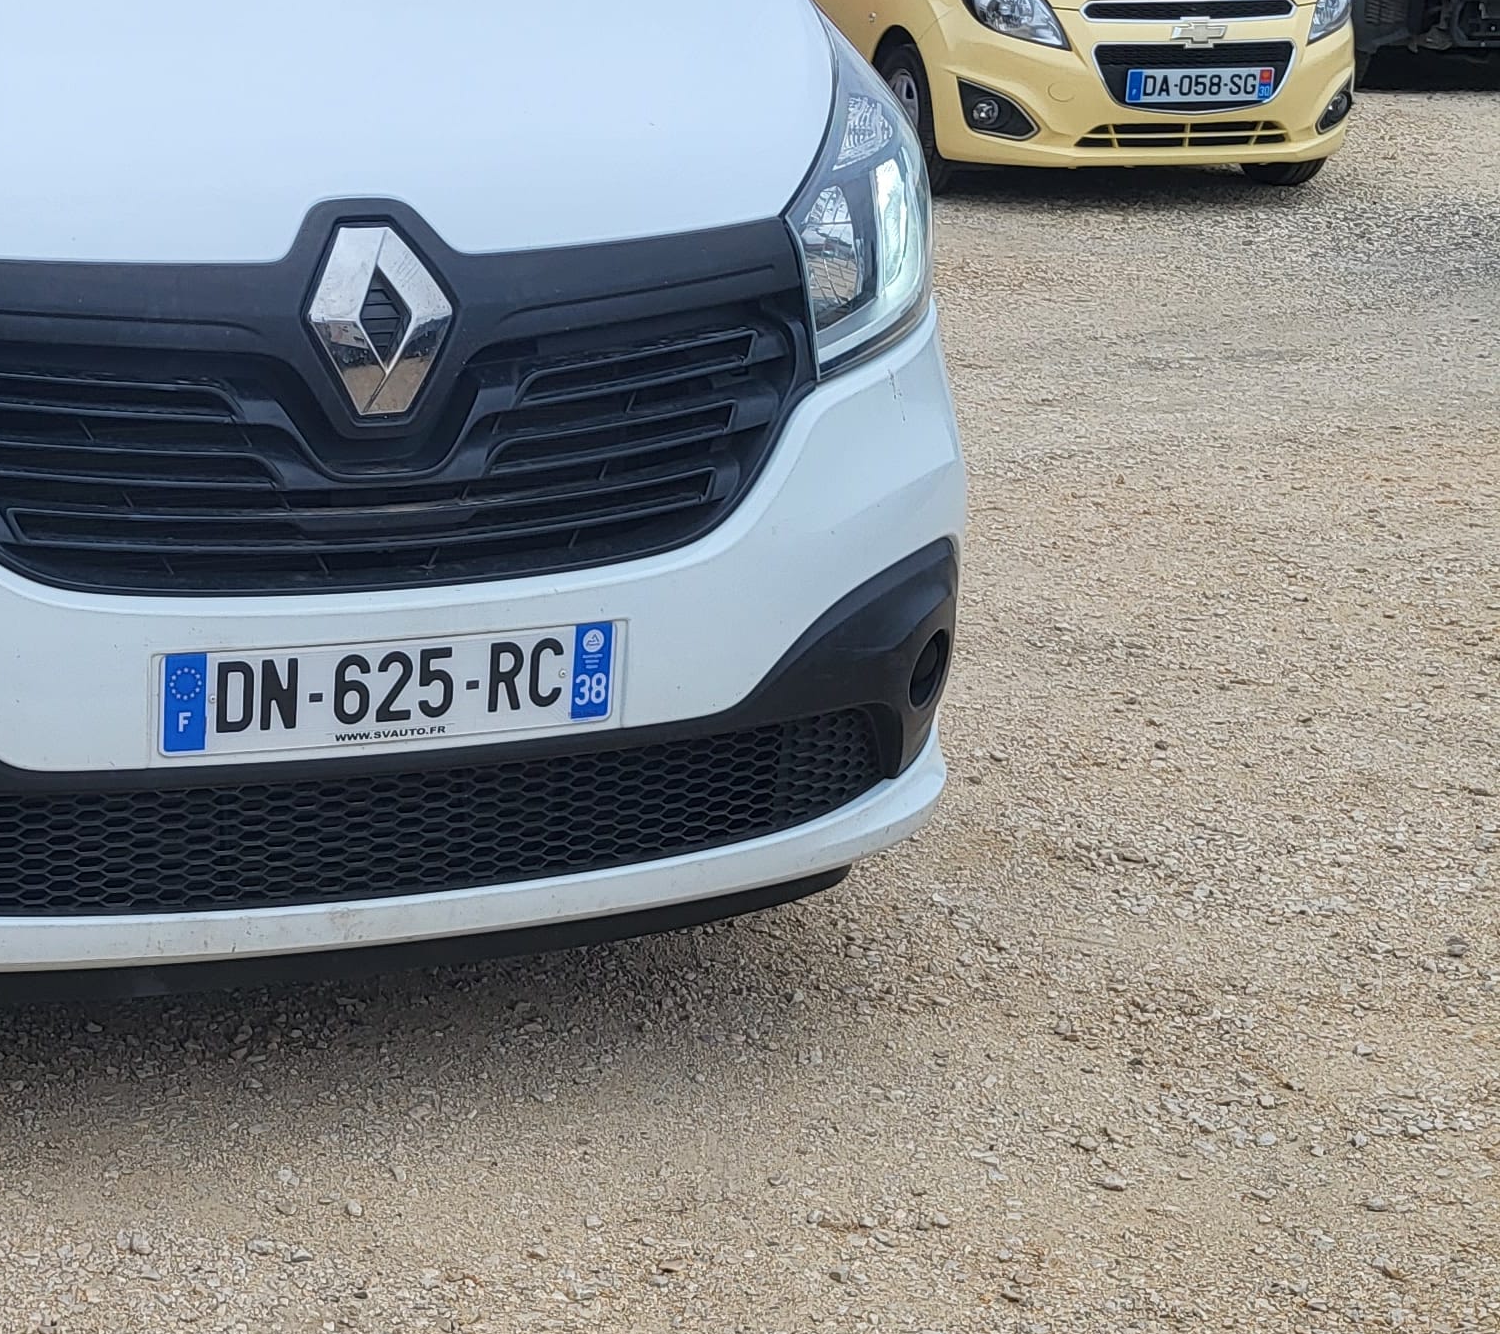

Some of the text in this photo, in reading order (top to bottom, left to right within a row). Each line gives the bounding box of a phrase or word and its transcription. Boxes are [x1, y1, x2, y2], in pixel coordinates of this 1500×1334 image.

[1142, 73, 1270, 97] DA-058-SG 30
[178, 637, 565, 734] F DN-625-RC
[574, 672, 607, 706] 38
[334, 725, 446, 742] WWW.SVAUTO.FR
